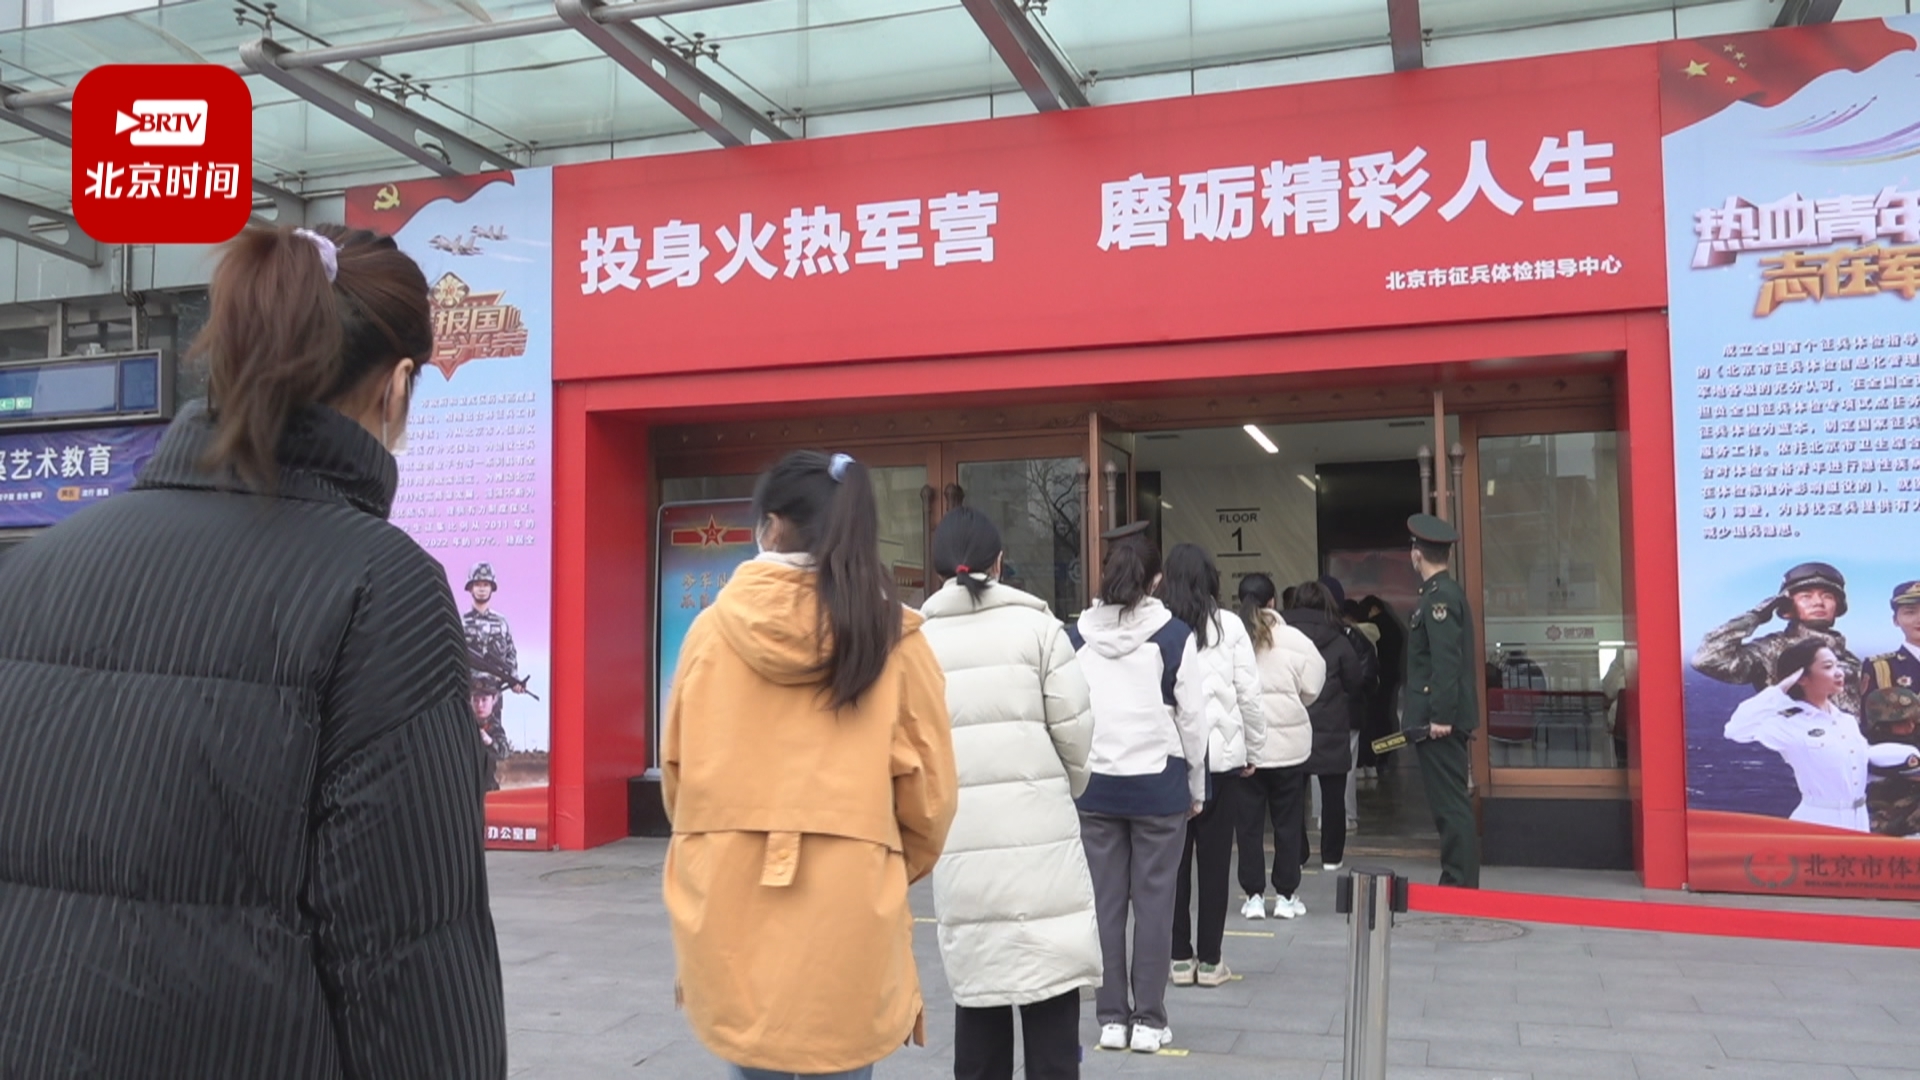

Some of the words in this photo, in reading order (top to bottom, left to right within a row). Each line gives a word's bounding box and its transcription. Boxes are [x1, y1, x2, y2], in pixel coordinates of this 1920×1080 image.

[580, 190, 999, 295] 投身火热军营
[1097, 130, 1619, 251] 磨砺精彩人生
[1691, 186, 1920, 269] 热血青年
[1385, 254, 1623, 290] 北京市征兵体检指导中心
[1219, 513, 1258, 523] FLOOR
[1231, 527, 1243, 551] 1
[1805, 853, 1920, 879] 北京市体
